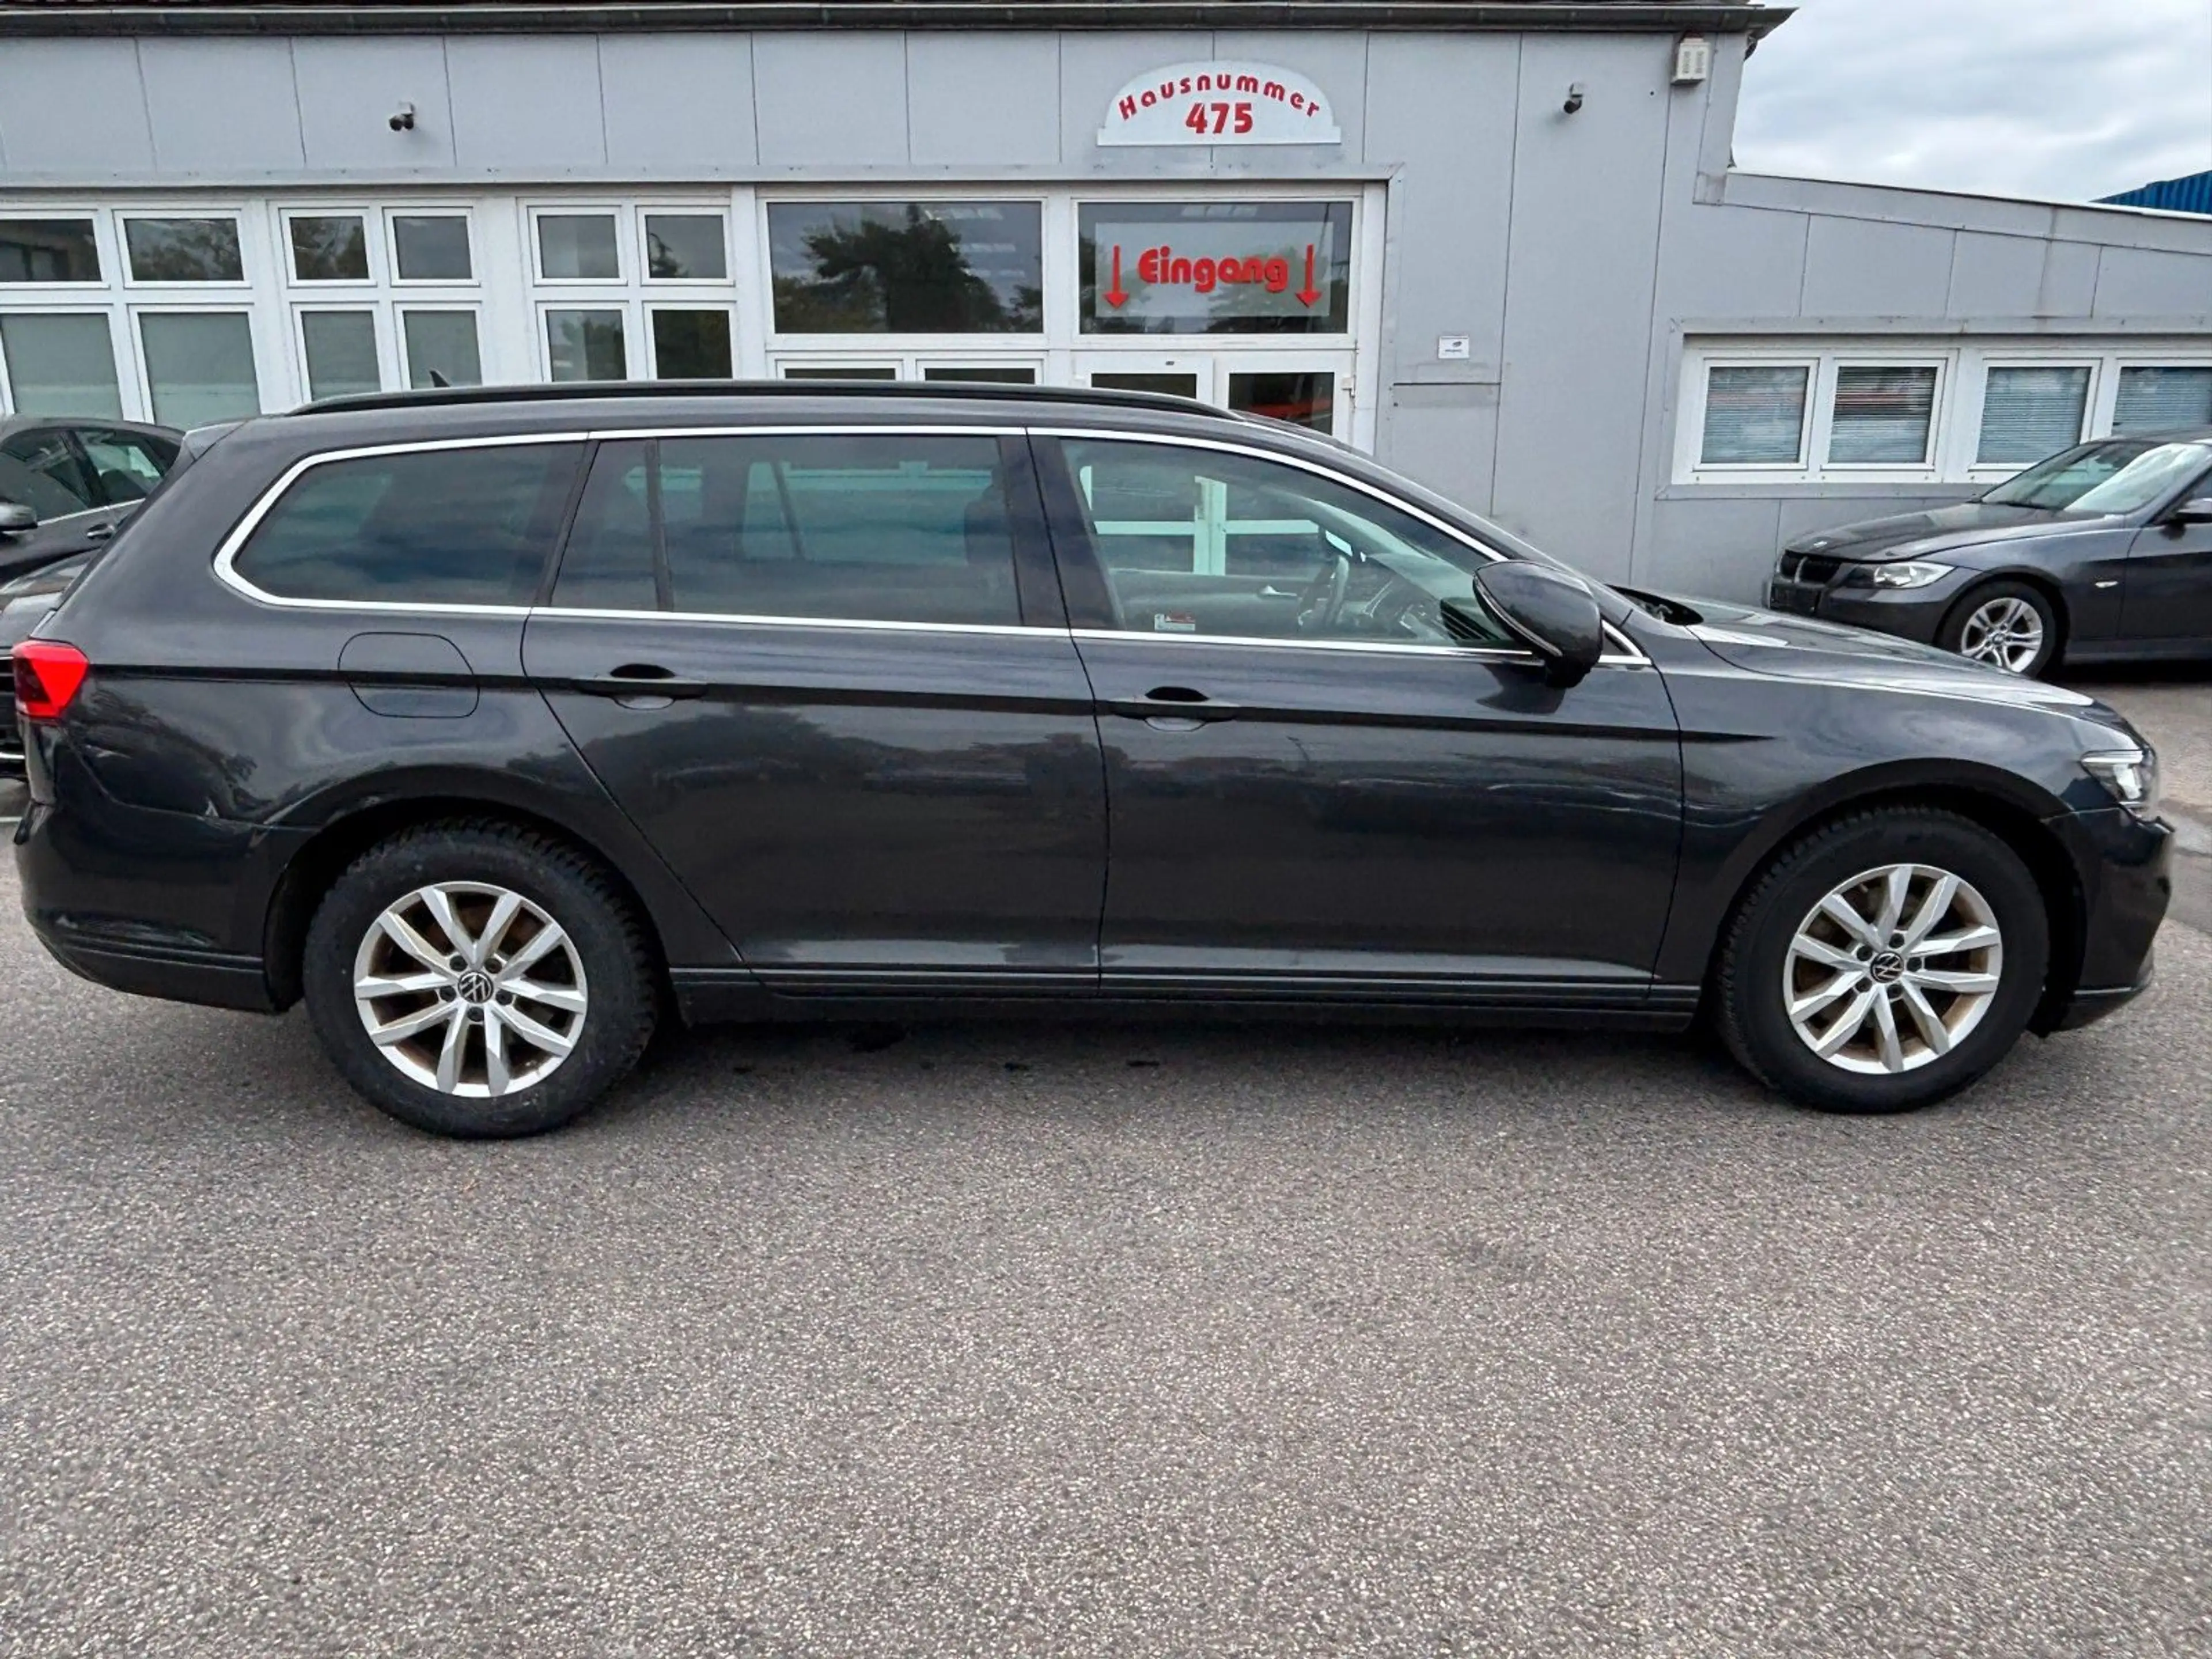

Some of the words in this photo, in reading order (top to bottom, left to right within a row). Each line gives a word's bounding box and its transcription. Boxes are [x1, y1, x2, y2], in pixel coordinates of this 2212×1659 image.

[1118, 74, 1320, 120] Hausnummer
[1185, 103, 1253, 134] 475
[1137, 245, 1289, 293] Eingang
